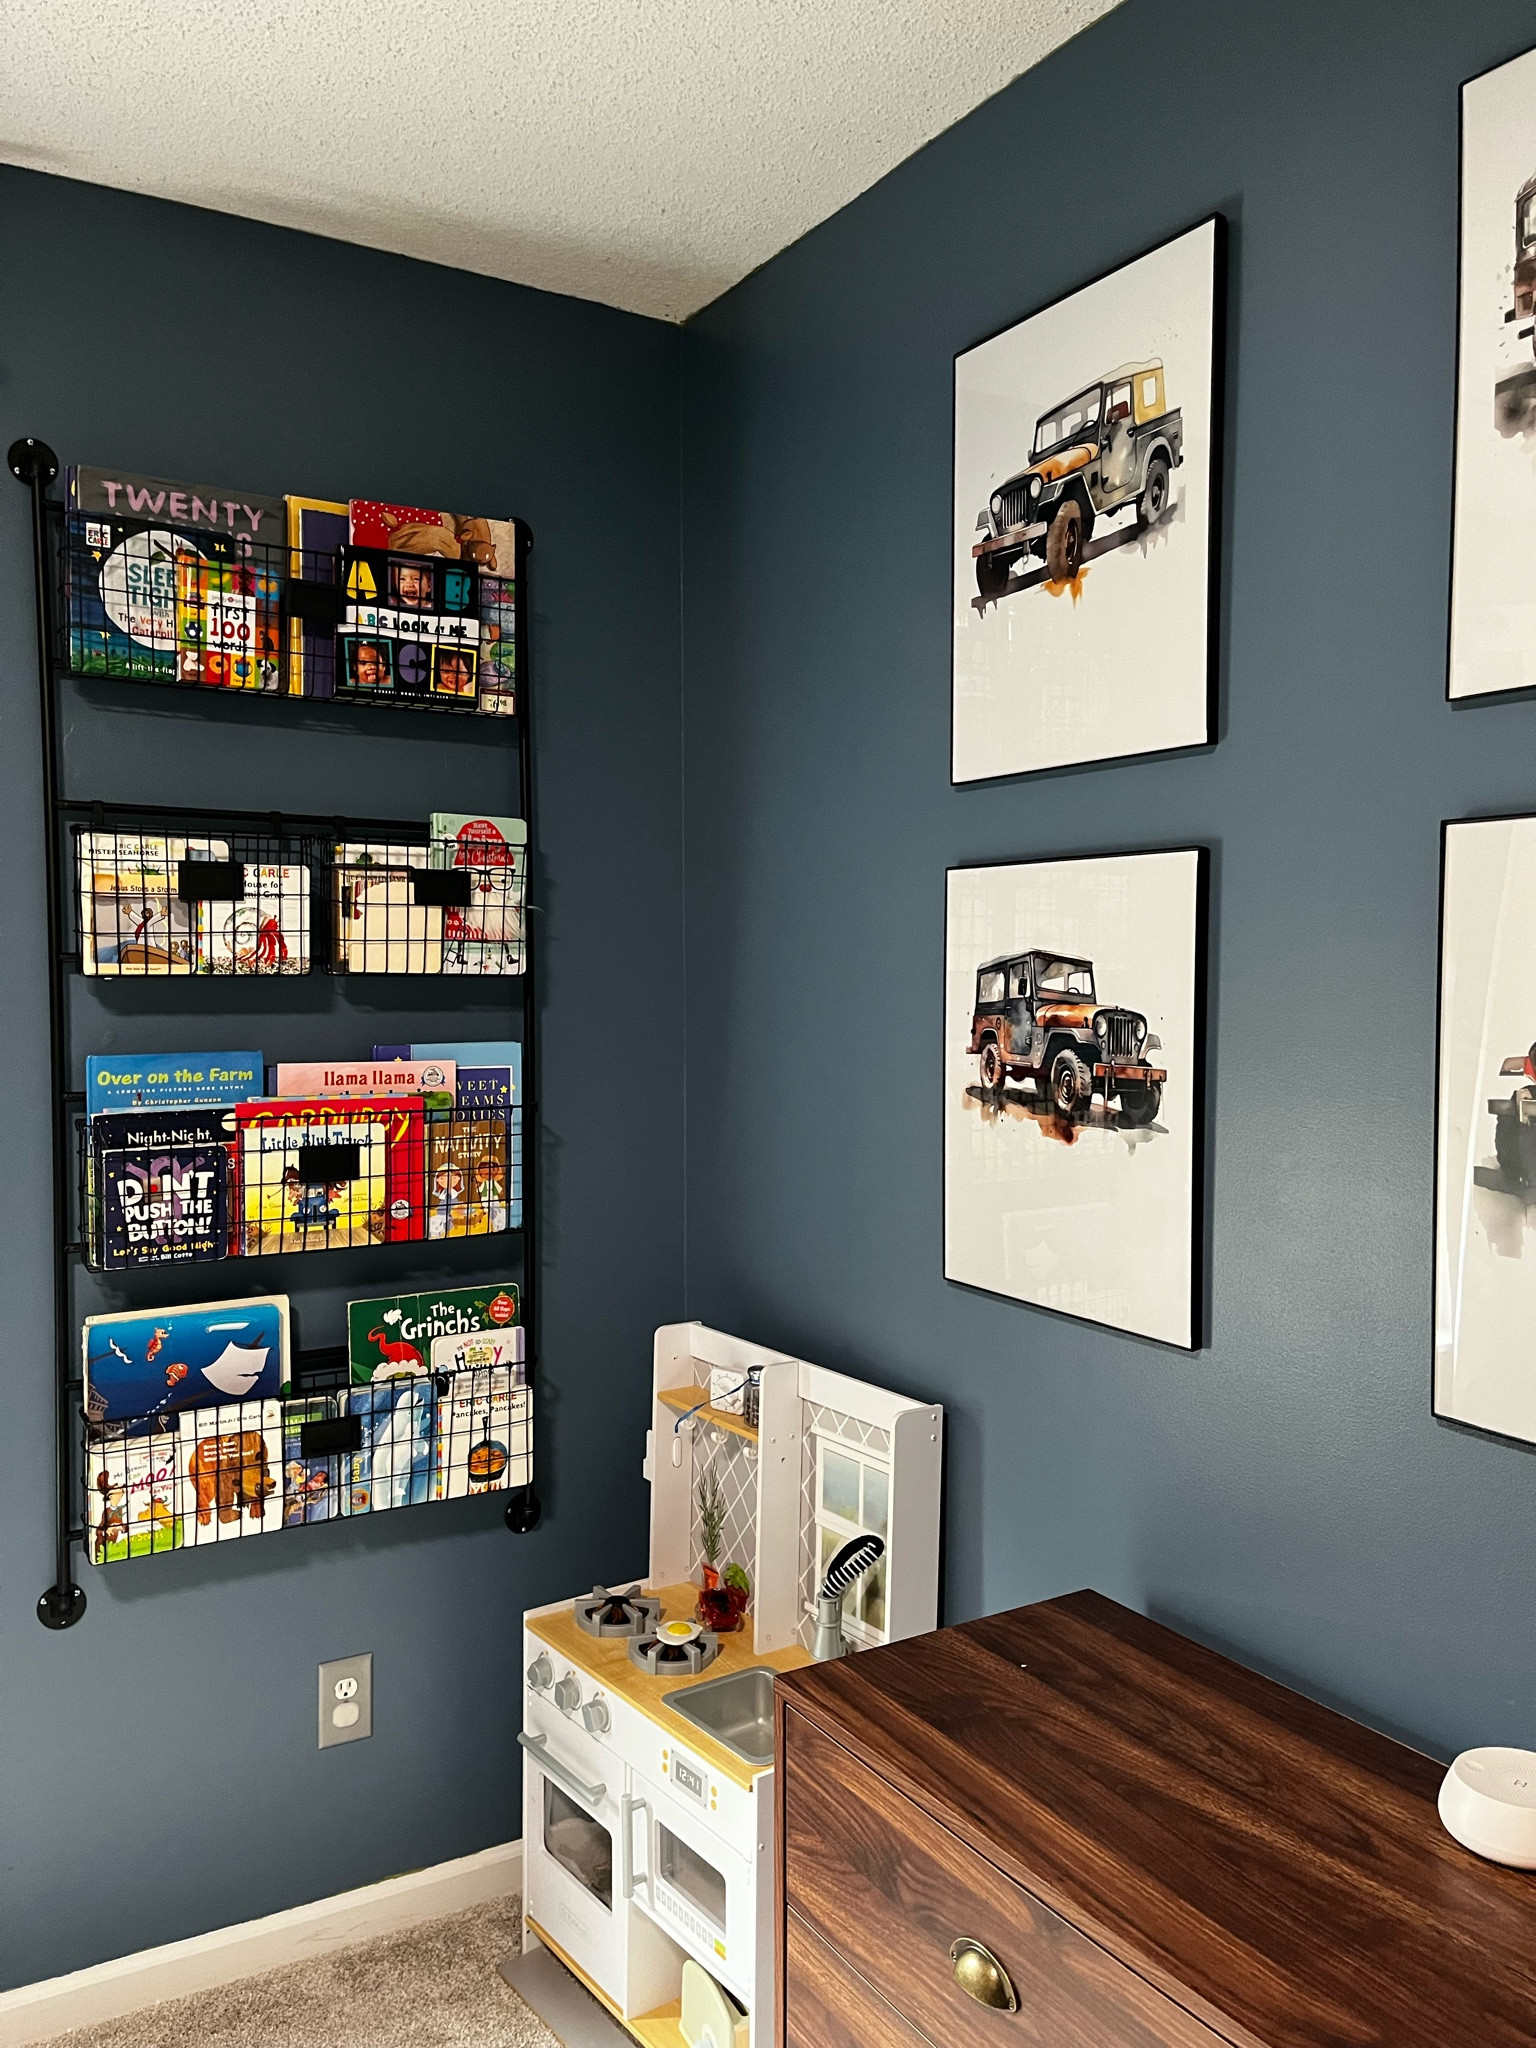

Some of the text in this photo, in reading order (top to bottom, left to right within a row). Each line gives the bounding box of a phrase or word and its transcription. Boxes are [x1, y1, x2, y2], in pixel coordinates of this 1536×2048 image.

[101, 480, 264, 532] TWENTY
[88, 529, 108, 539] ERC
[211, 602, 249, 620] frst
[211, 618, 251, 641] 100
[393, 617, 431, 634] LOOK
[449, 625, 468, 637] ME
[471, 850, 508, 865] Christma
[131, 885, 150, 893] Stos
[156, 885, 178, 893] Stom
[270, 880, 283, 889] fo
[97, 1067, 254, 1086] Over on the Farm
[324, 1070, 415, 1086] llama llama
[461, 1094, 504, 1106] EAMS
[456, 1109, 505, 1121] ORIES
[262, 1136, 298, 1151] Litle
[435, 1133, 502, 1154] NATIVITY
[117, 1170, 215, 1207] DN'T
[122, 1199, 213, 1223] PUSH THE
[127, 1216, 212, 1243] BUTTON!
[141, 1246, 158, 1255] Sy
[173, 1252, 193, 1260] Cotte
[430, 1301, 455, 1317] The
[400, 1308, 481, 1340] Grinch's
[679, 1767, 700, 1791] 12:41
